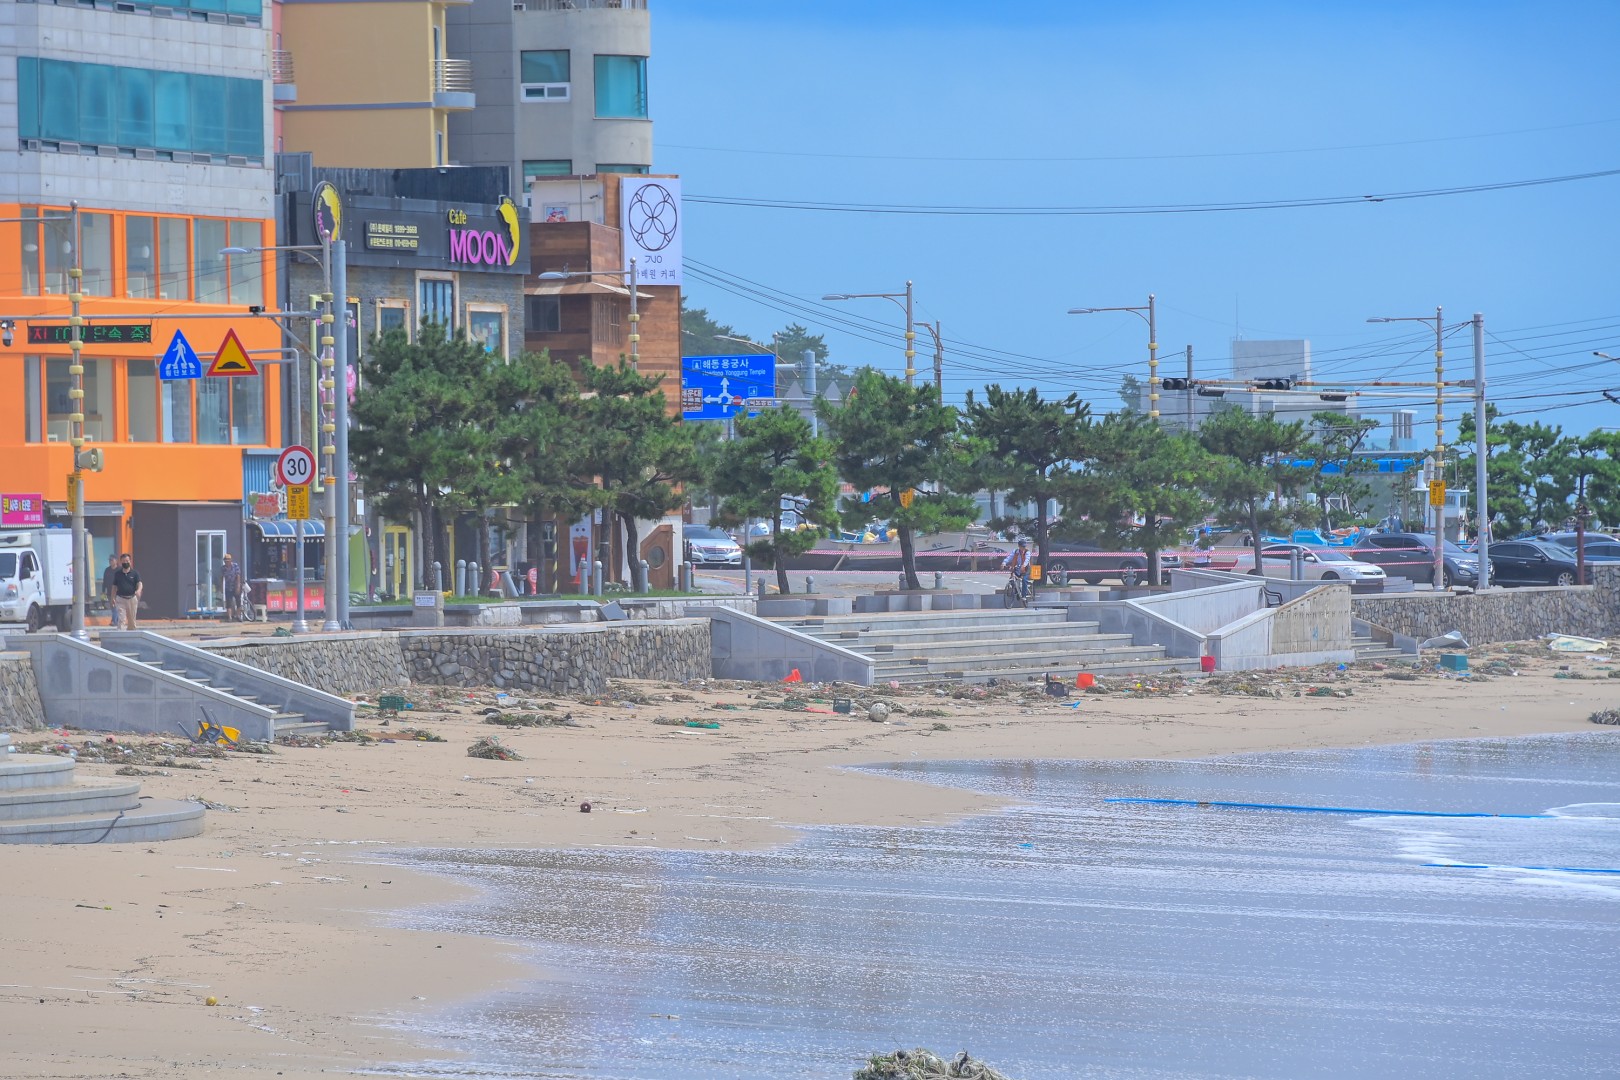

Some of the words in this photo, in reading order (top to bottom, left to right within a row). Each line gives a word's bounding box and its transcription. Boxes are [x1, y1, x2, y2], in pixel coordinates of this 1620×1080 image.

[449, 209, 467, 225] Cafe
[450, 229, 511, 266] MOON
[660, 269, 676, 280] 커피
[93, 326, 123, 341] 단속
[287, 457, 307, 476] 30
